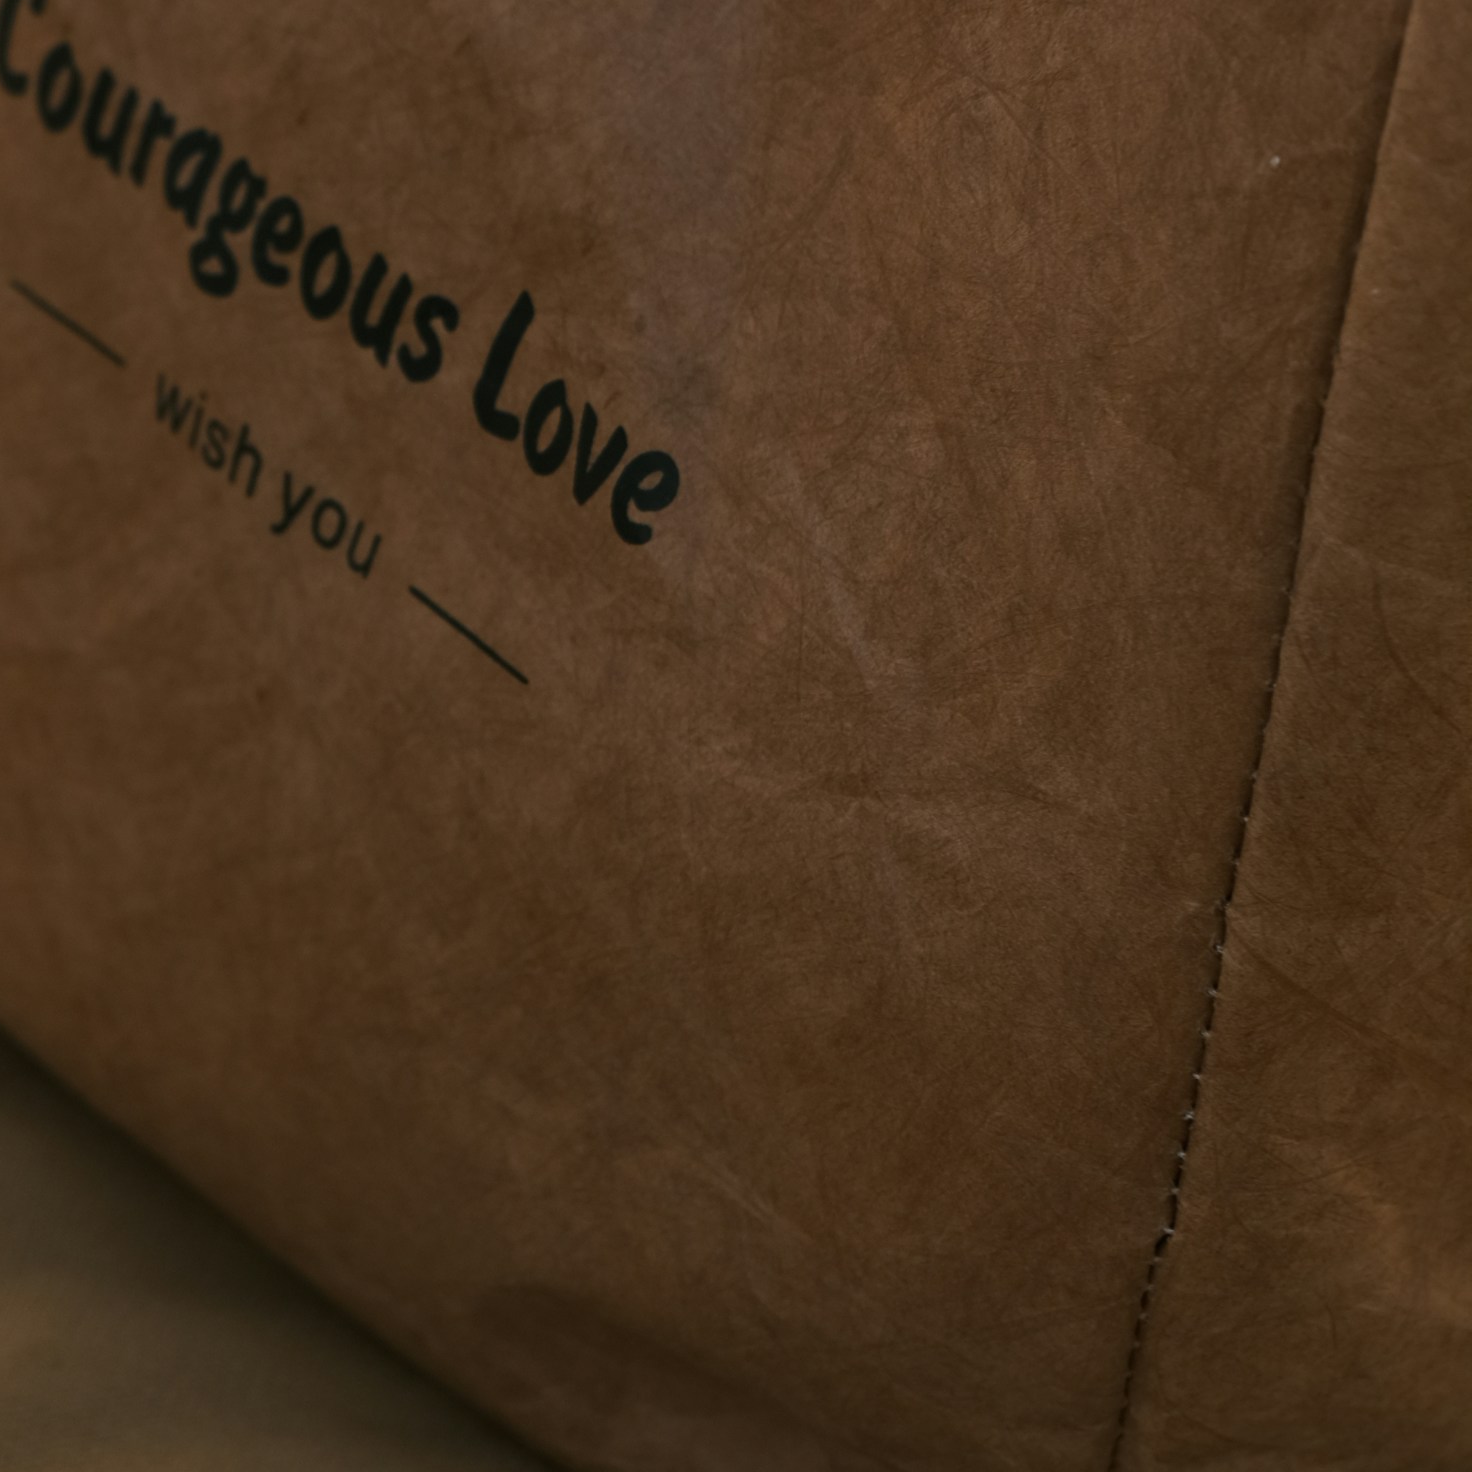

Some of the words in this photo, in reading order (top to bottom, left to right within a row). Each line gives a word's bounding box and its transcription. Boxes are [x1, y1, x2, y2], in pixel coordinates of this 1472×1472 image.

[153, 372, 266, 499] wish
[269, 470, 385, 580] you
[472, 290, 681, 546] Love
